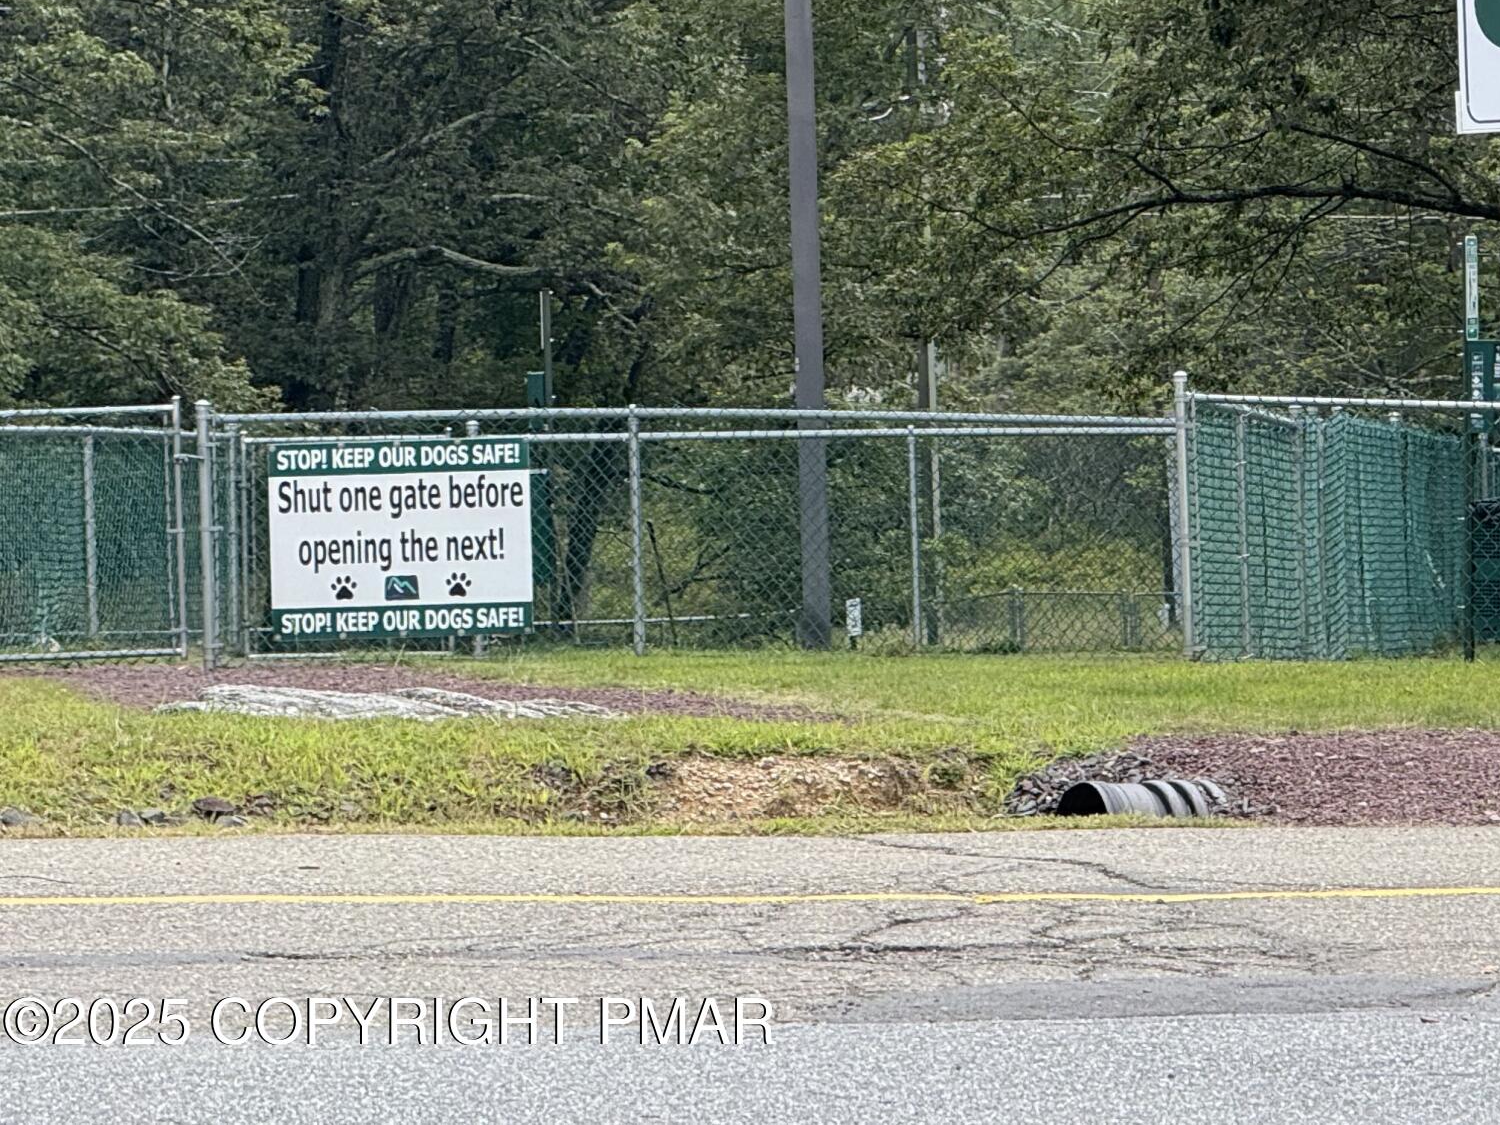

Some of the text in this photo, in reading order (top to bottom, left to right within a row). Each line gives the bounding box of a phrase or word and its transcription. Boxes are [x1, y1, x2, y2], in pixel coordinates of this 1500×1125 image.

[277, 443, 520, 470] STOP! KEEP OUR DOGS SAFE!
[279, 475, 523, 518] Shut one gate before
[299, 528, 504, 573] opening the next!
[282, 607, 524, 634] STOP! KEEP OUR DOGS SAFE!
